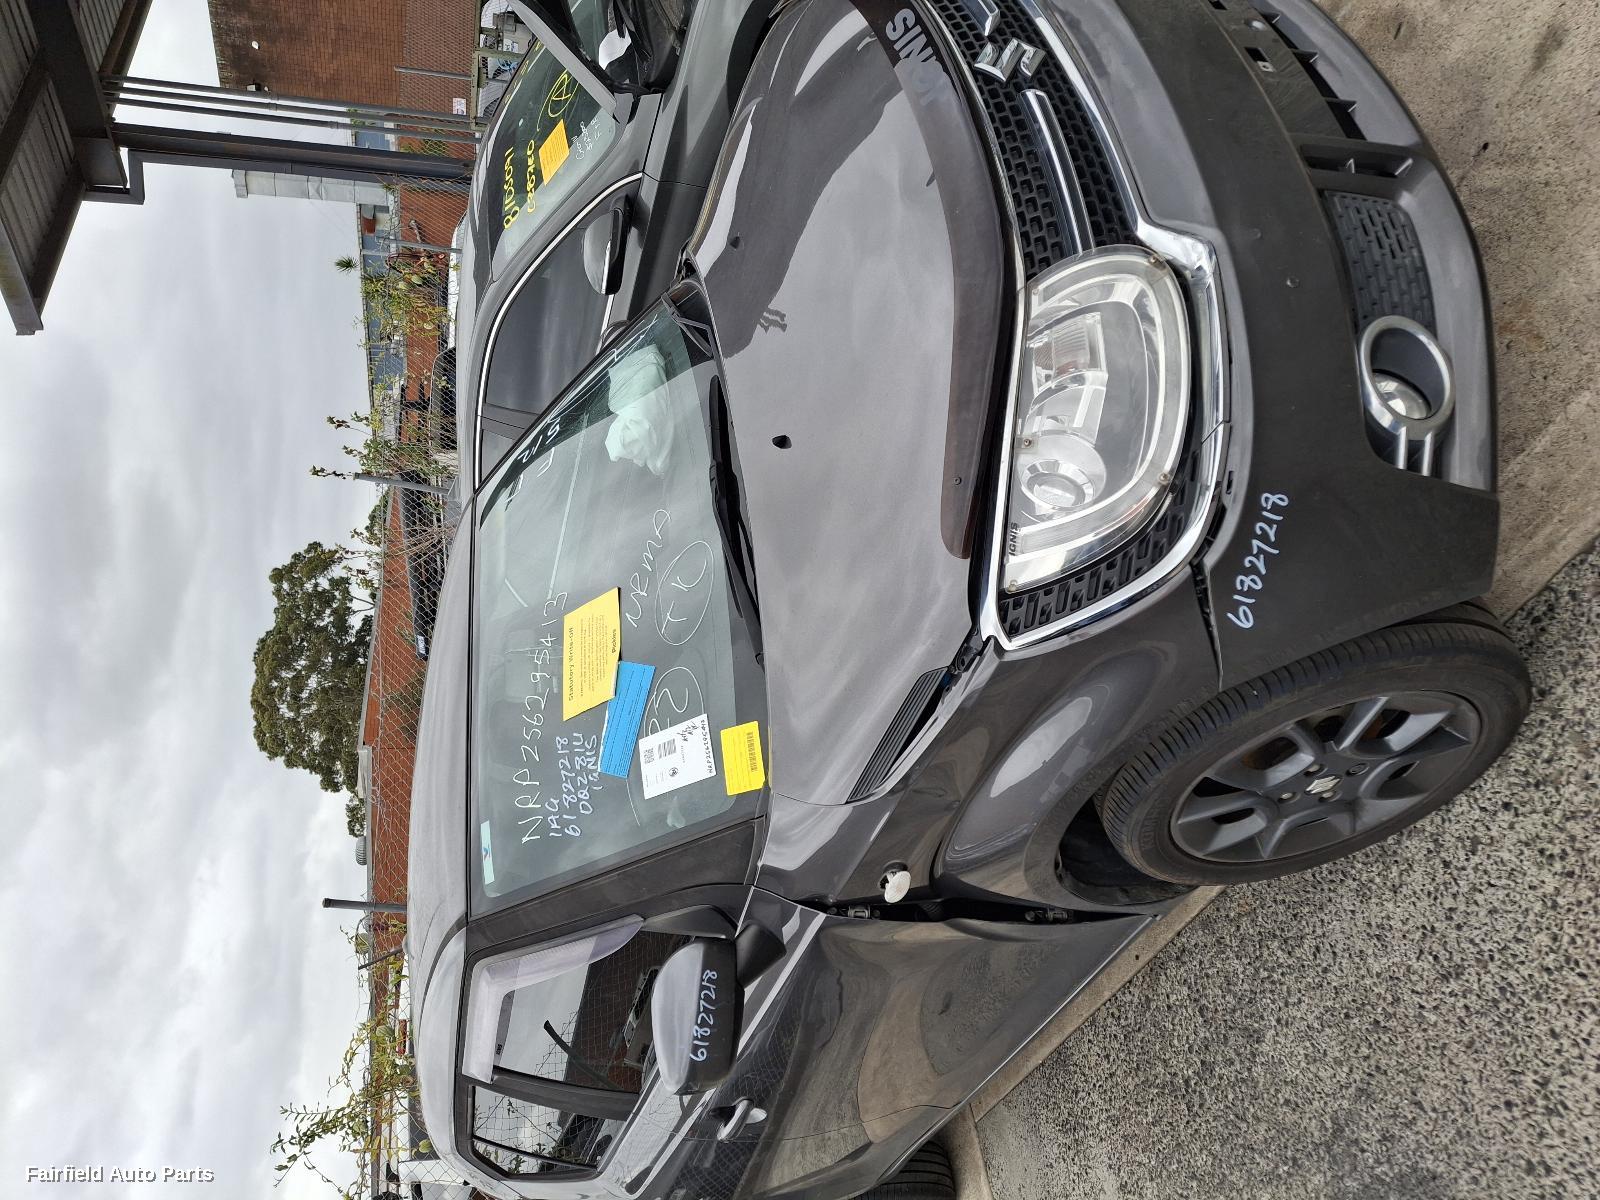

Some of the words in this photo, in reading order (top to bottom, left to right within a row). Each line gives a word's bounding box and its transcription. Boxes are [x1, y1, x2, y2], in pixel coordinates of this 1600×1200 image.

[1008, 521, 1018, 557] IGNIS
[1226, 492, 1289, 629] 61827218
[689, 969, 719, 1062] 61827218
